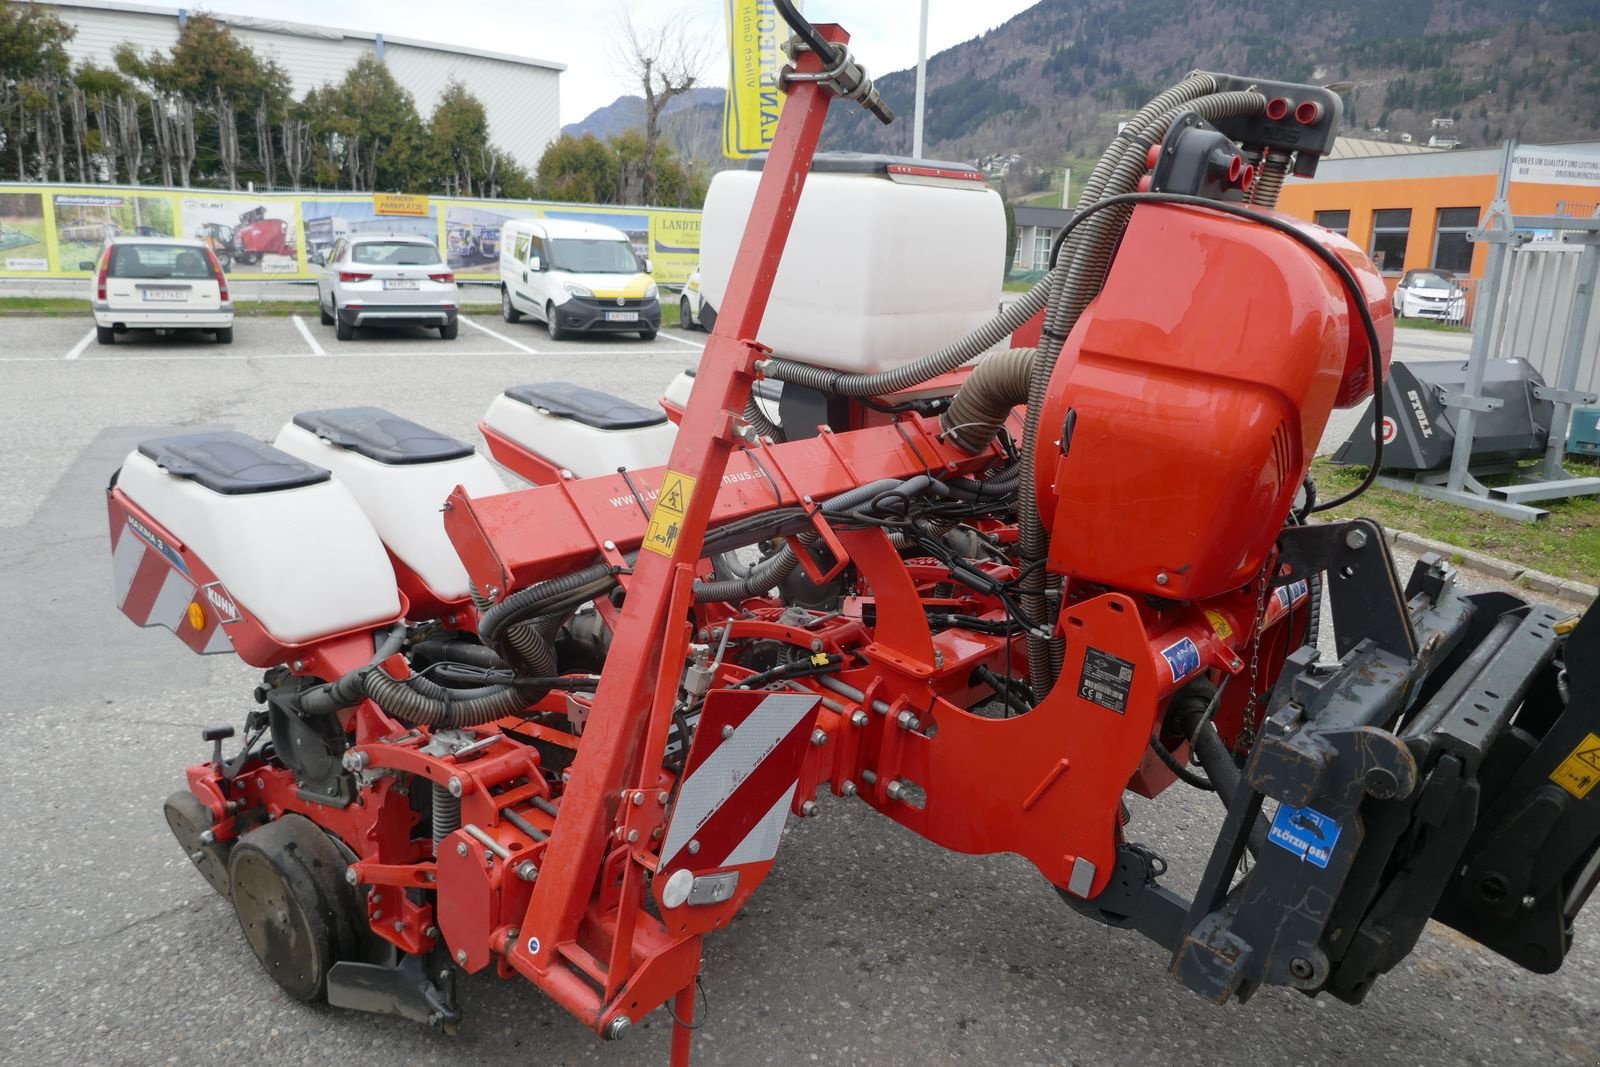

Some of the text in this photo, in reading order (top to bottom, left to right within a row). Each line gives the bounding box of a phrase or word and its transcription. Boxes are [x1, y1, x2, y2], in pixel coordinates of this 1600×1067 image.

[1407, 390, 1433, 439] STOLL
[128, 514, 158, 545] MAXIMA
[207, 586, 236, 619] KUHN
[1271, 826, 1328, 862] FLÖTZINGER
